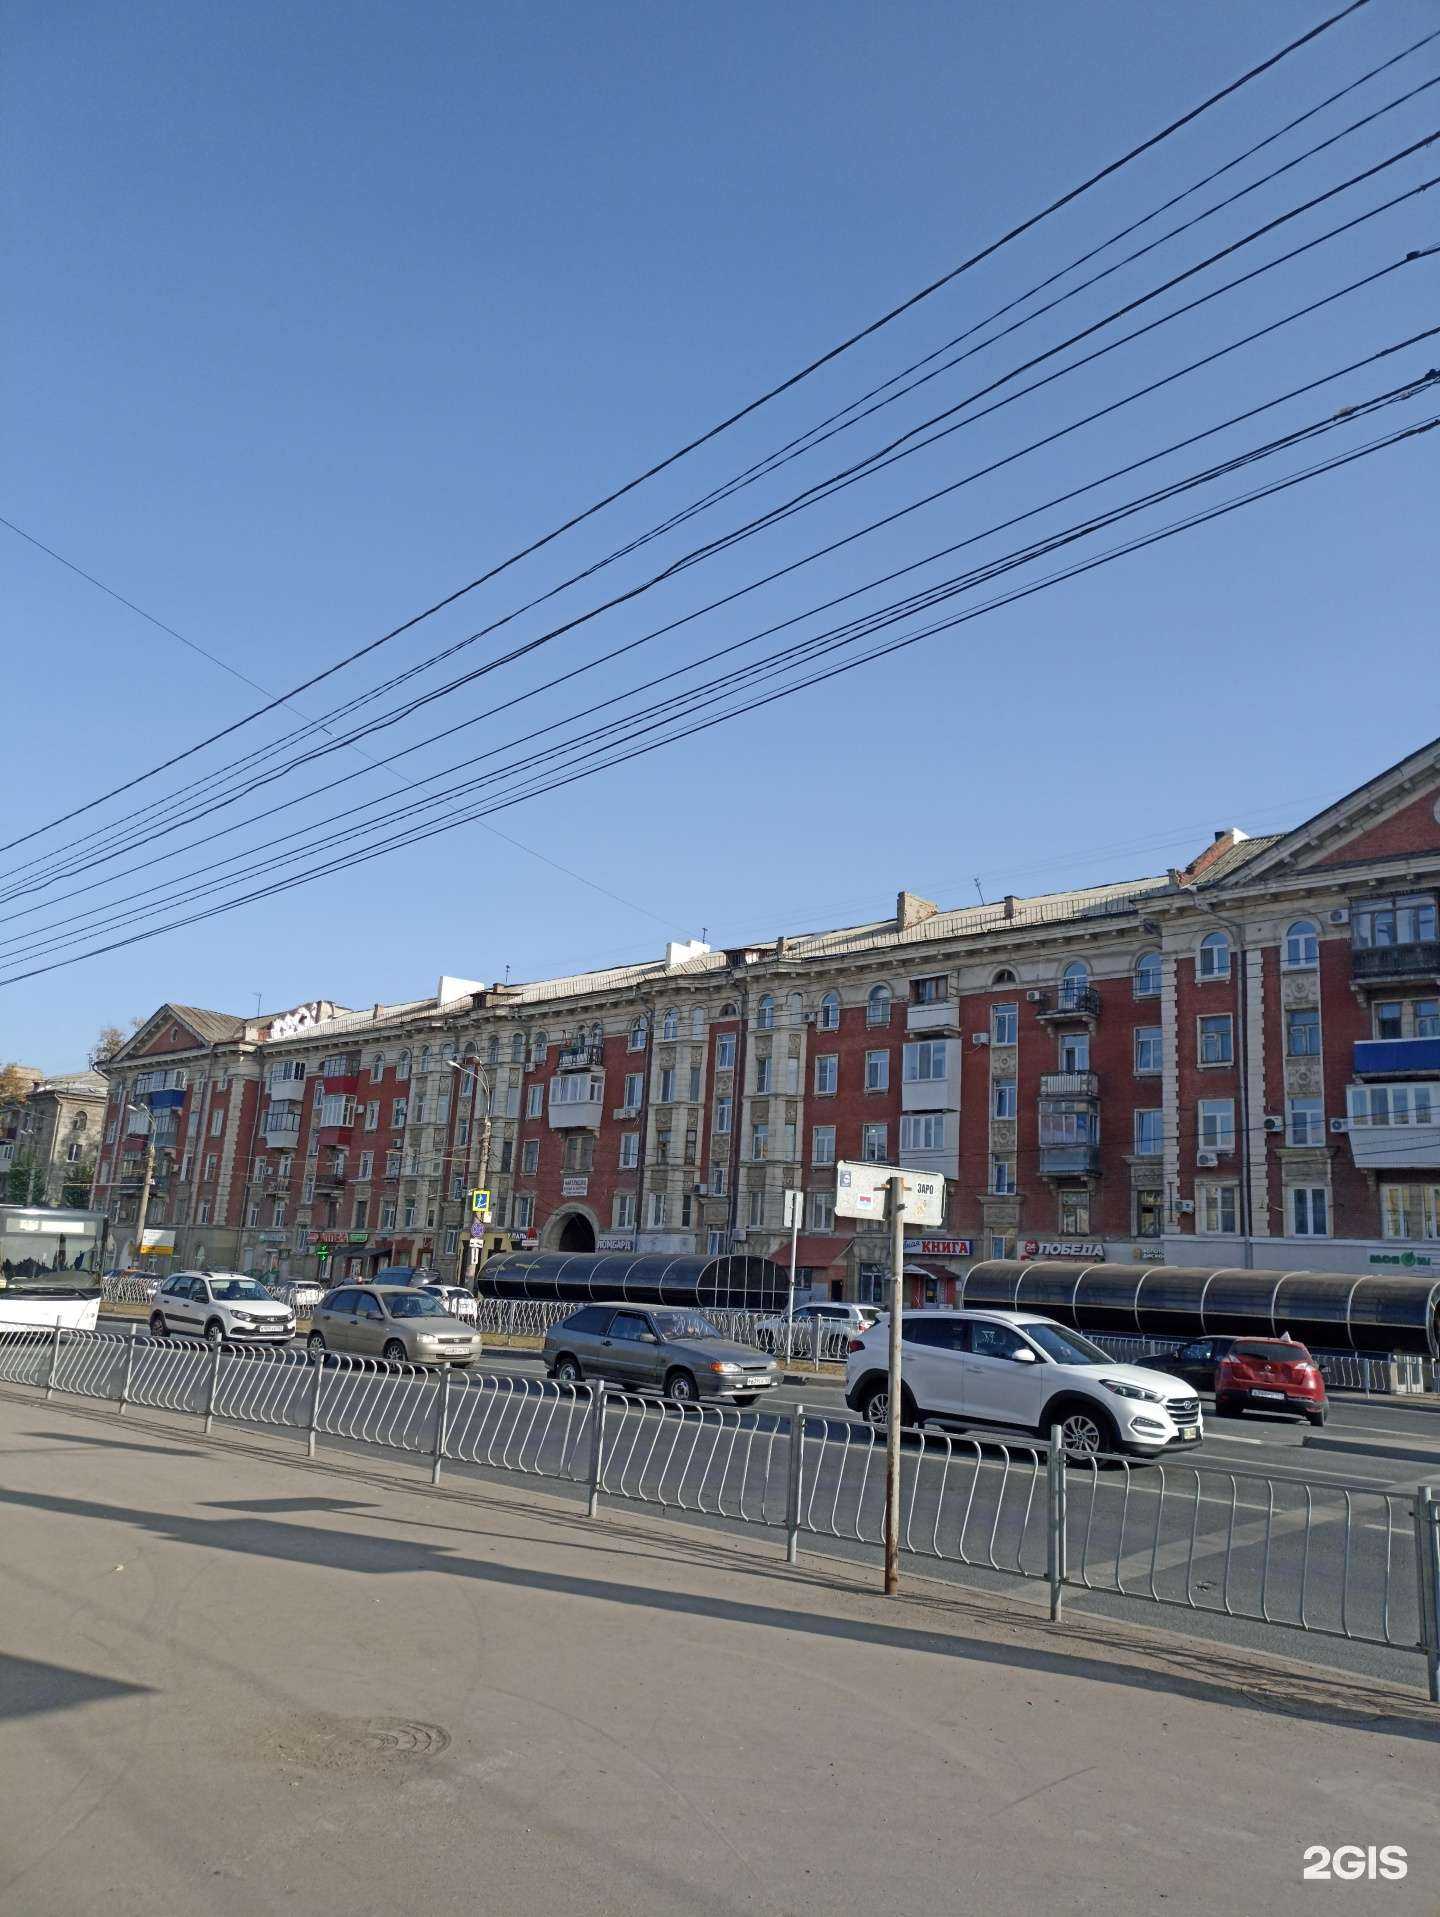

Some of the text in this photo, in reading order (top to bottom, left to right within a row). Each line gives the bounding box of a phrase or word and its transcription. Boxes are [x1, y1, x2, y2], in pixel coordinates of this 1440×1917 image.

[597, 1240, 631, 1250] ЛОМБАРД
[921, 1241, 968, 1254] КНИГА
[1039, 1243, 1104, 1256] ПОБЕДА
